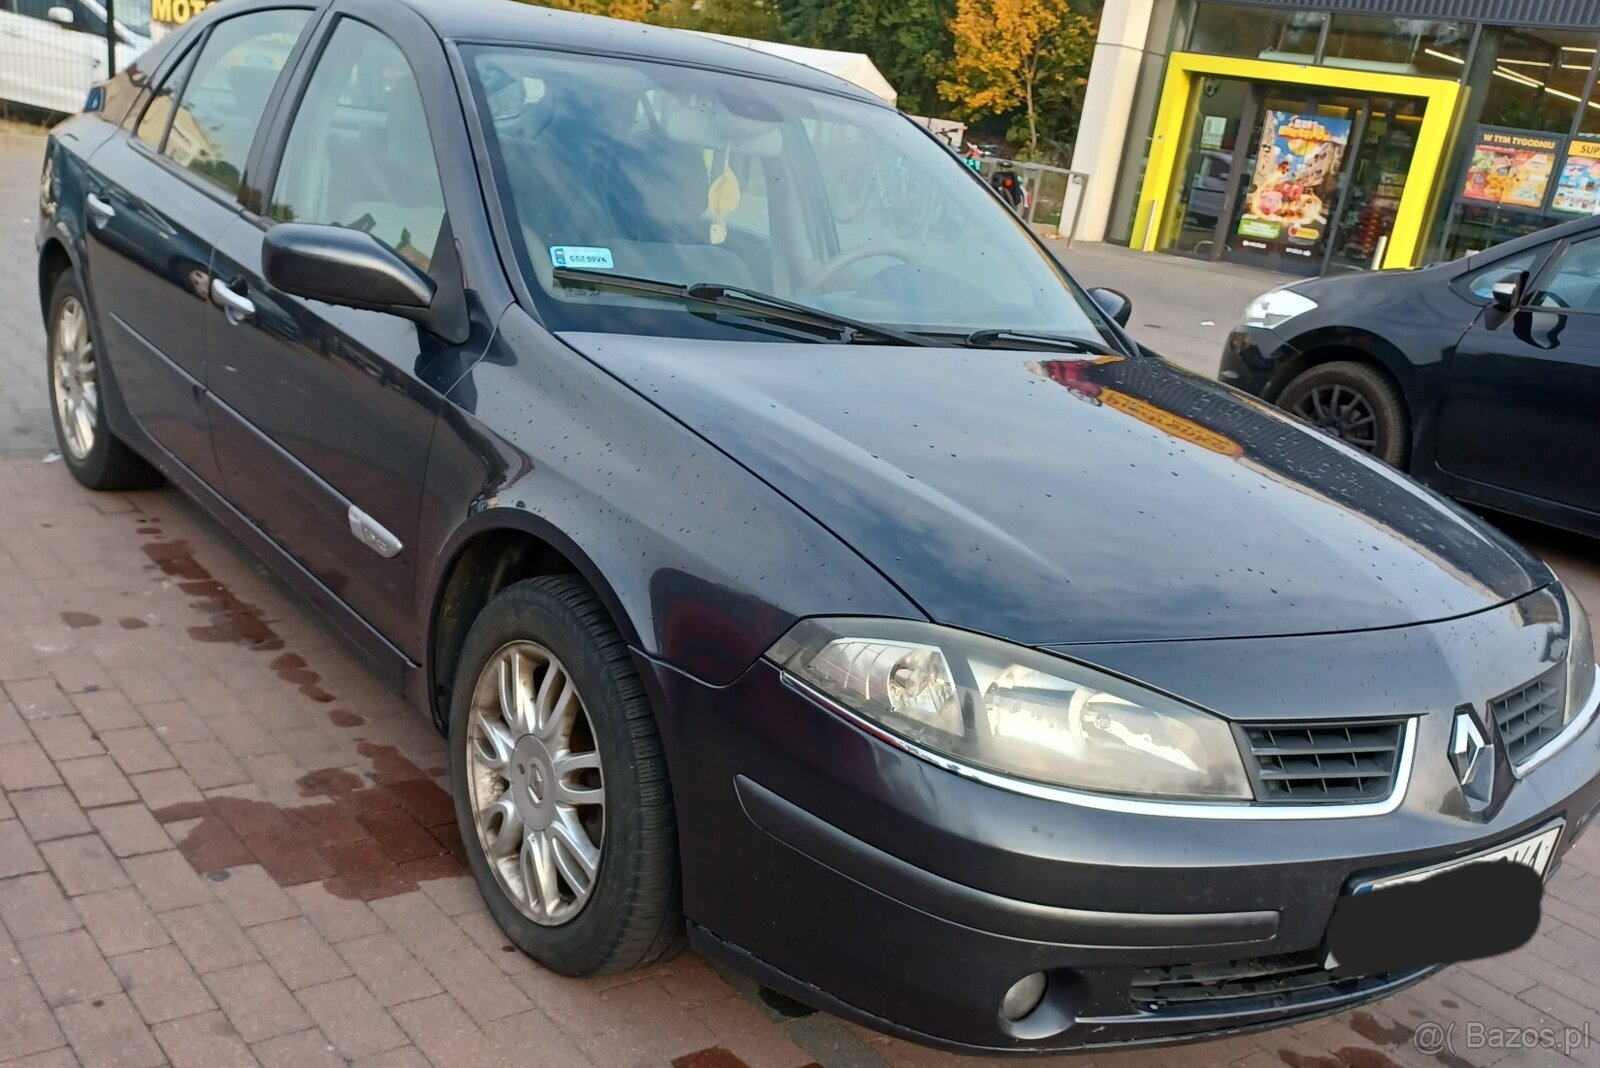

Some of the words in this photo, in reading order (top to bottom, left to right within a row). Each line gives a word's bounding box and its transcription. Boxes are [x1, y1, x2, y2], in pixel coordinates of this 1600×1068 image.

[1483, 133, 1493, 142] W
[1493, 134, 1511, 144] TYM
[1512, 136, 1556, 149] TYGODNIU
